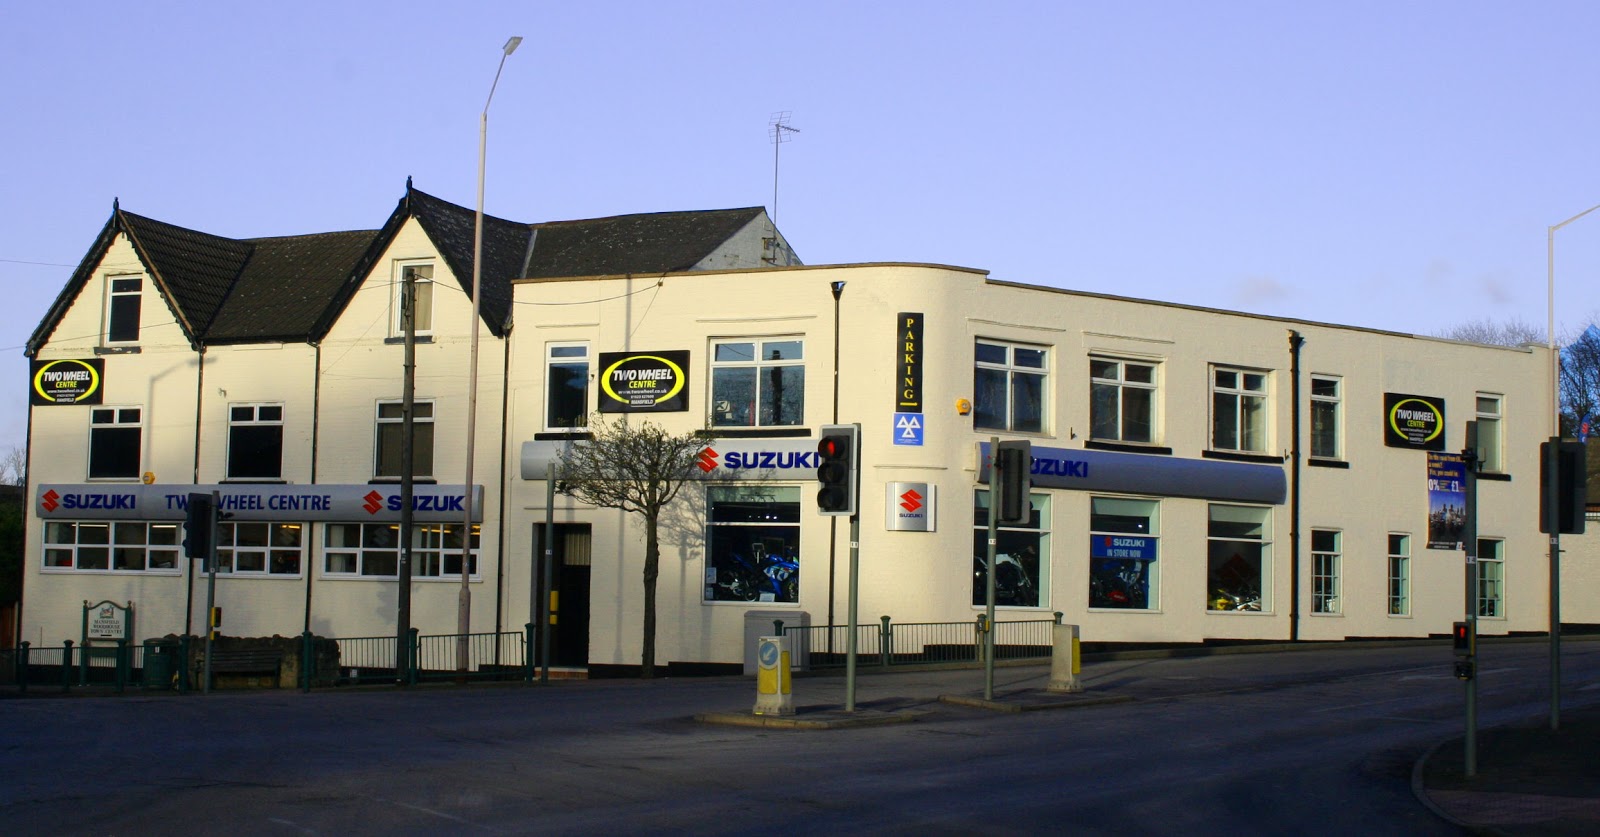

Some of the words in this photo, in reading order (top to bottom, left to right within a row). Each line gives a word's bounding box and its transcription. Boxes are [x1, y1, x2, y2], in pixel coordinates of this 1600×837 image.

[903, 318, 915, 399] PARKING
[43, 371, 62, 381] TWO
[62, 371, 90, 381] WHEEL
[613, 370, 637, 381] TWO
[637, 369, 673, 380] WHEEL
[628, 380, 656, 389] CENTRE
[1396, 409, 1412, 420] TWO
[1412, 411, 1435, 422] WHEEL
[1406, 420, 1425, 428] CENTRE
[724, 452, 820, 469] SUZUKI
[1030, 458, 1088, 478] UZUKI
[1428, 479, 1440, 491] 0%
[63, 493, 136, 510] SUZUKI
[165, 494, 188, 510] TW
[268, 494, 331, 511] CENTRE
[387, 495, 465, 511] SZUK
[1113, 538, 1145, 547] SUZUKI
[1106, 548, 1113, 557] IN
[1113, 548, 1129, 557] STORE
[1129, 549, 1142, 558] NOW
